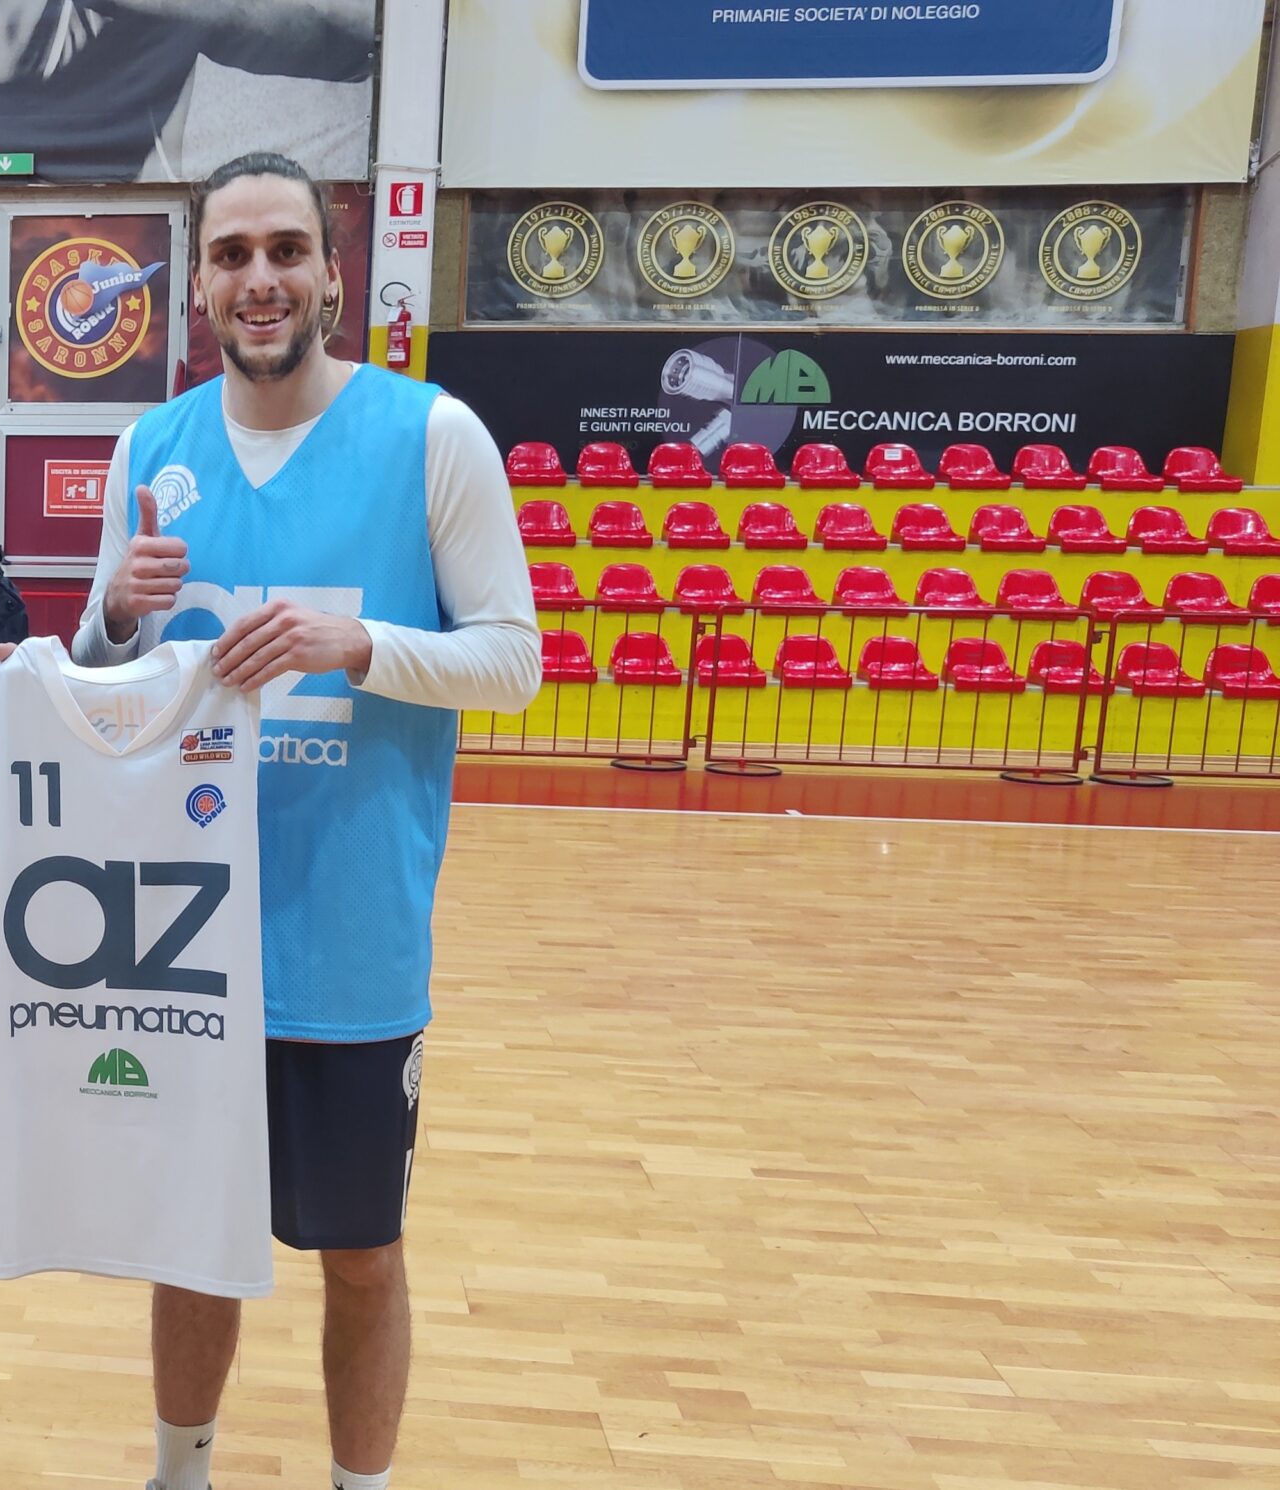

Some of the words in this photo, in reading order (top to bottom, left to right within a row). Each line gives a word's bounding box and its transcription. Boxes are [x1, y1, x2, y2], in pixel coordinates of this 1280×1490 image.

[712, 8, 790, 23] PRIMARIE
[794, 7, 868, 22] SOCIETA'
[870, 6, 888, 21] DI
[892, 4, 980, 20] NOLEGGIO
[32, 248, 122, 292] BASK
[92, 271, 142, 294] Junior
[28, 318, 137, 368] SARONNO
[885, 353, 1077, 367] www.meccanica-borroni.com
[580, 407, 628, 419] INNESTI
[630, 408, 671, 419] RAPIDI
[802, 410, 953, 432] MECCANICA
[958, 411, 1077, 433] BORRONI
[579, 421, 588, 432] E
[590, 421, 632, 432] GIUNTI
[634, 421, 691, 433] GIREVOLI
[156, 487, 202, 528] OBUR
[200, 728, 234, 742] LNP
[11, 760, 61, 827] 11
[198, 801, 228, 829] ROBUR
[3, 855, 231, 998] az
[10, 1000, 225, 1041] pneumatica
[80, 1087, 122, 1097] MECCANICA
